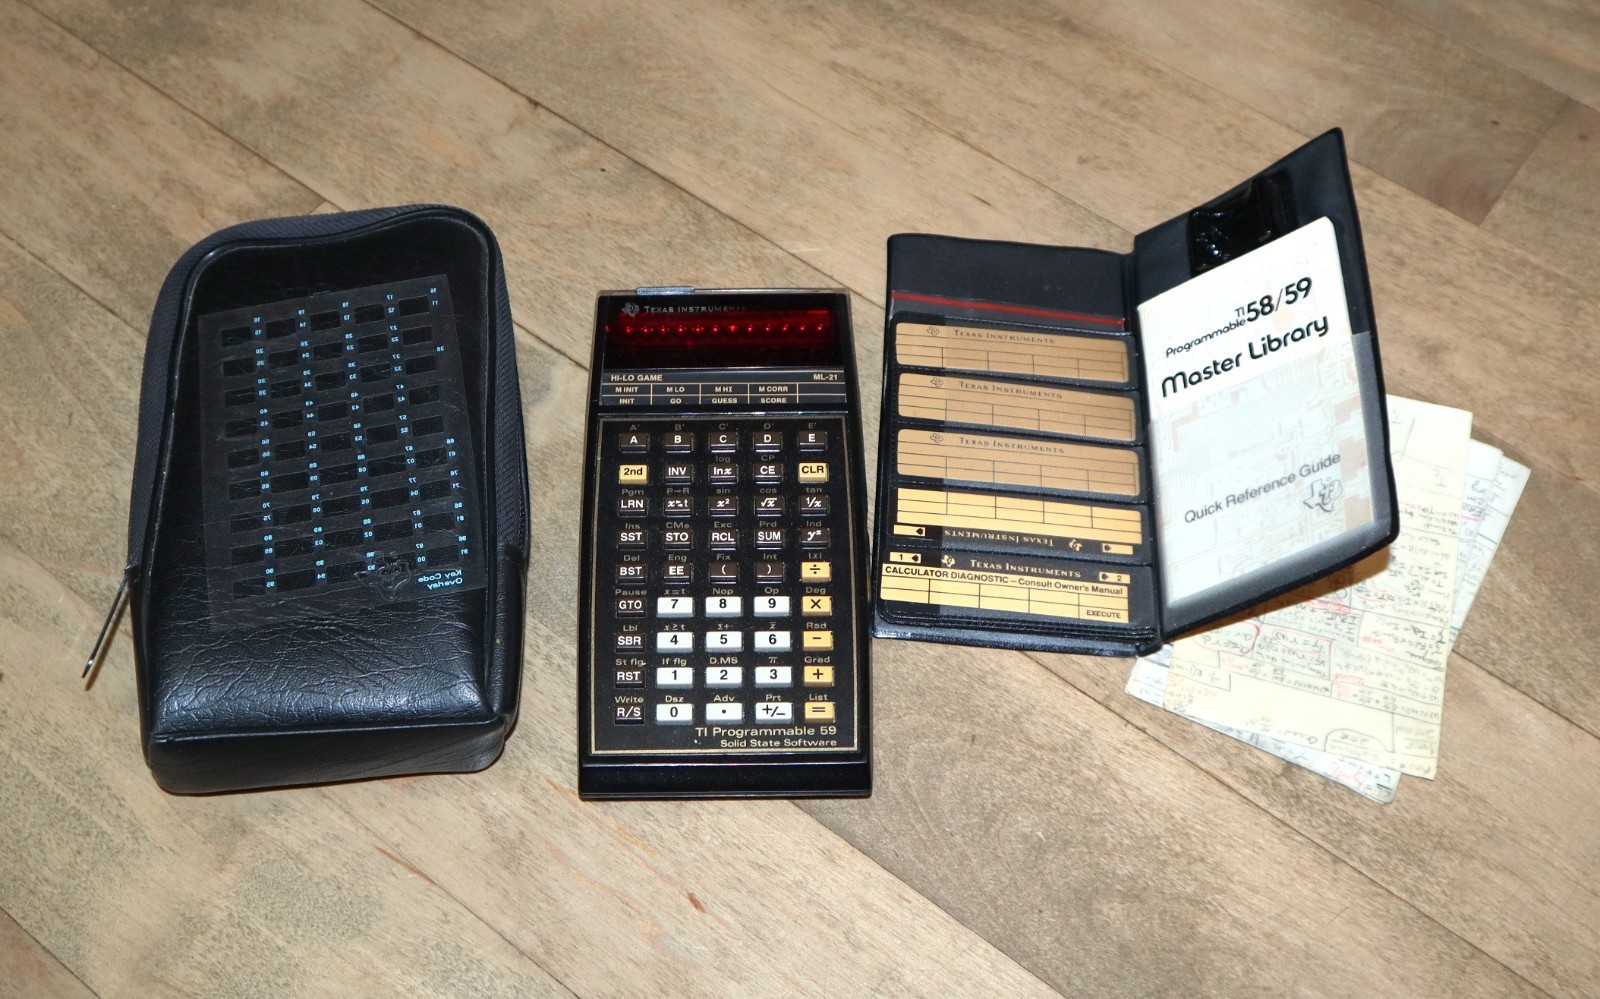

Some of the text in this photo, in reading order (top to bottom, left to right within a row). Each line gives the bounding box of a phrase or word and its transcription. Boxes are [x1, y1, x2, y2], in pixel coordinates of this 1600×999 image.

[1246, 276, 1313, 323] 58/59
[1165, 318, 1247, 358] Programmable
[1161, 315, 1330, 398] Master Library
[610, 374, 663, 382] HI-LO GAME
[812, 373, 838, 381] ML-21
[629, 435, 638, 444] A
[674, 435, 682, 444] B
[719, 434, 727, 443] C
[763, 434, 772, 443] D
[808, 433, 816, 442] E
[623, 467, 643, 476] 2nd
[668, 466, 687, 476] INV
[760, 465, 776, 475] CE
[801, 465, 824, 474] CLR
[621, 488, 645, 497] Pgm
[1184, 453, 1341, 524] Quick Reference Guide
[620, 499, 644, 509] LRN
[759, 520, 777, 528] Prd
[620, 531, 643, 542] SST
[665, 532, 689, 542] STO
[711, 532, 735, 541] RCL
[757, 531, 781, 541] SUM
[623, 554, 640, 562] Del
[668, 553, 688, 563] Eng
[619, 566, 643, 576] BST
[668, 566, 685, 575] EE
[885, 566, 949, 579] CALCULATOR
[950, 571, 1009, 584] DIAGNOSTIC
[1018, 577, 1052, 588] Consult
[1091, 585, 1124, 595] Manual
[614, 588, 648, 596] Pause
[712, 587, 734, 596] Nop
[764, 586, 780, 595] Op
[805, 586, 827, 595] Deg
[618, 600, 643, 610] GTO
[670, 599, 679, 609] 7
[718, 598, 727, 609] 8
[768, 598, 776, 609] 9
[1086, 609, 1121, 619] EXECUTE
[806, 622, 827, 630] Rad
[617, 635, 642, 646] SBR
[670, 634, 679, 645] 4
[719, 634, 728, 645] 5
[768, 634, 777, 645] 6
[804, 656, 831, 664] Grad
[616, 671, 641, 681] RST
[719, 669, 728, 680] 2
[769, 668, 778, 680] 3
[614, 695, 644, 704] Write
[665, 695, 685, 703] Dsz
[713, 694, 736, 702] Adv
[765, 693, 782, 702] Prt
[808, 693, 828, 701] List
[616, 705, 642, 718] R/S
[670, 706, 679, 718] 0
[695, 725, 837, 738] TI Programmable 59
[720, 738, 837, 748] Solid State Software
